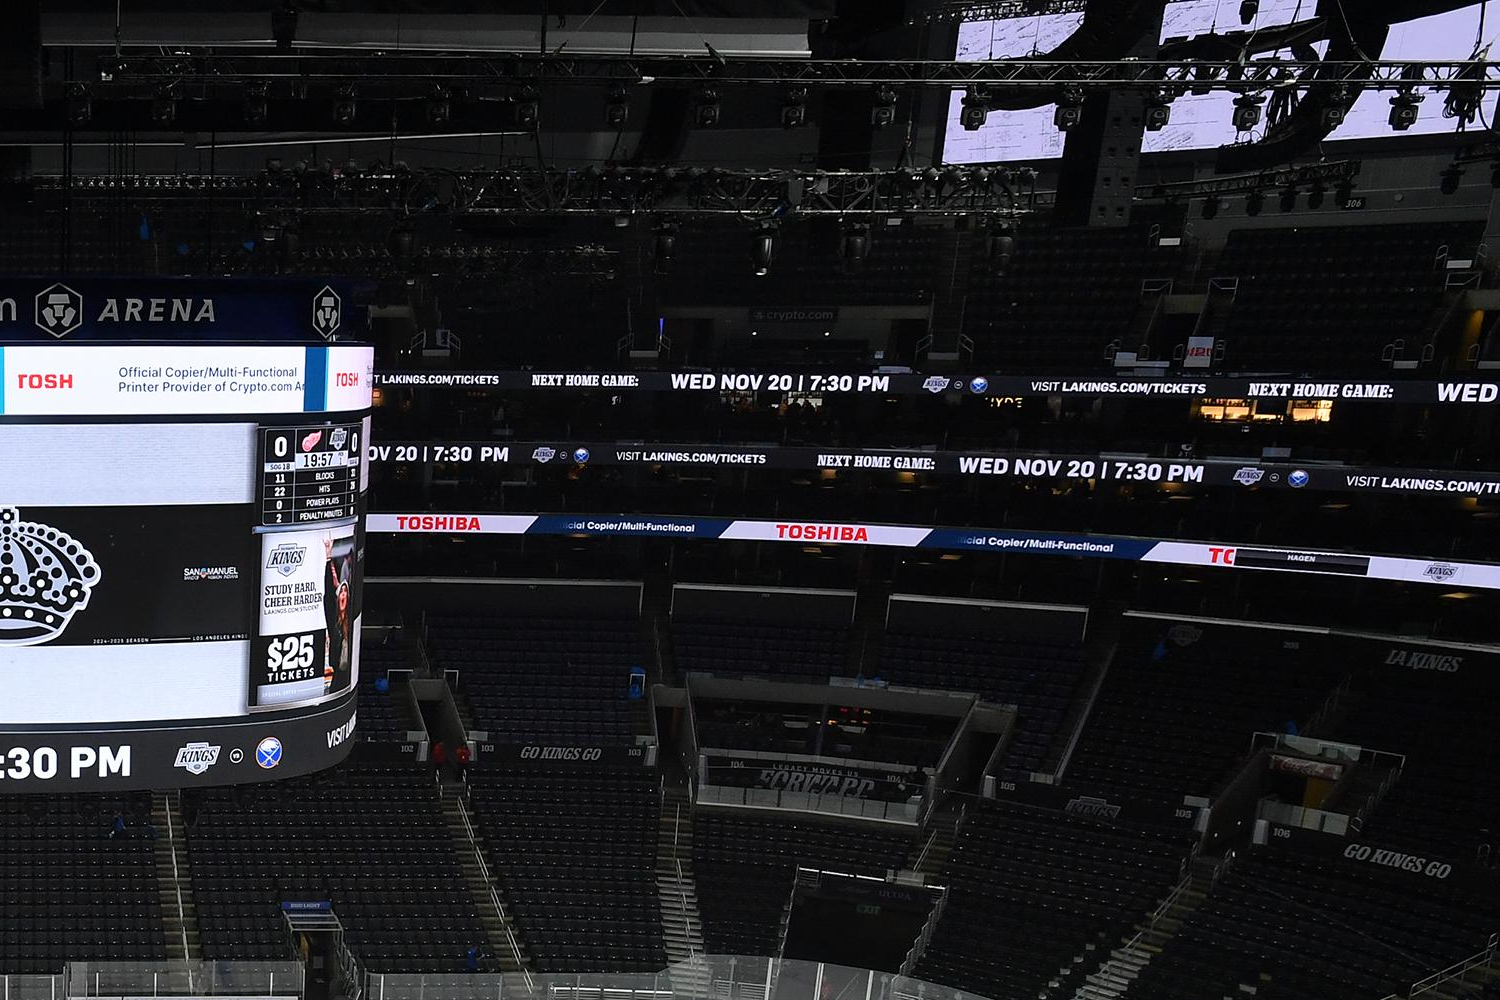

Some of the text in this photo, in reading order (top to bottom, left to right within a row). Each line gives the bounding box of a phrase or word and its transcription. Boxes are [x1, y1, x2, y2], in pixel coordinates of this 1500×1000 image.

[98, 299, 215, 322] ARENA
[766, 310, 834, 322] crypto.com
[382, 374, 499, 387] LAKINGS.COM/TICKETS
[1031, 382, 1206, 395] VISIT LAKINGS.COM/TICKETS
[1248, 383, 1498, 402] NEXT HOME GAME: WED
[274, 436, 287, 457] 0
[304, 453, 333, 468] 19:57
[616, 451, 766, 465] VISIT LAKINGS.COM/TICKETS
[817, 454, 935, 470] NEXT HOME GAME:
[316, 472, 335, 480] BLOCKS
[959, 458, 1204, 482] WED NOV 20 7:30 PM
[275, 474, 285, 483] 11
[274, 487, 285, 497] 22
[319, 485, 331, 493] HITS
[397, 516, 480, 531] TOSHIBA
[587, 522, 694, 533] Copier/Multi-Functional
[776, 524, 868, 541] TOSHIBA
[988, 537, 1113, 553] Copier/Multi-Functional
[271, 550, 303, 565] KINGS
[184, 566, 238, 575] SAN MANUEL
[264, 581, 317, 596] STUDY HARD,
[264, 592, 323, 608] CHEER HARDER
[267, 634, 315, 672] $25
[1385, 650, 1463, 672] LA KINGS
[267, 667, 315, 683] TICKETS
[180, 751, 214, 763] KINGS
[520, 747, 602, 760] GO KINGS GO
[70, 745, 131, 779] PM
[1344, 843, 1452, 879] GO KINGS GO
